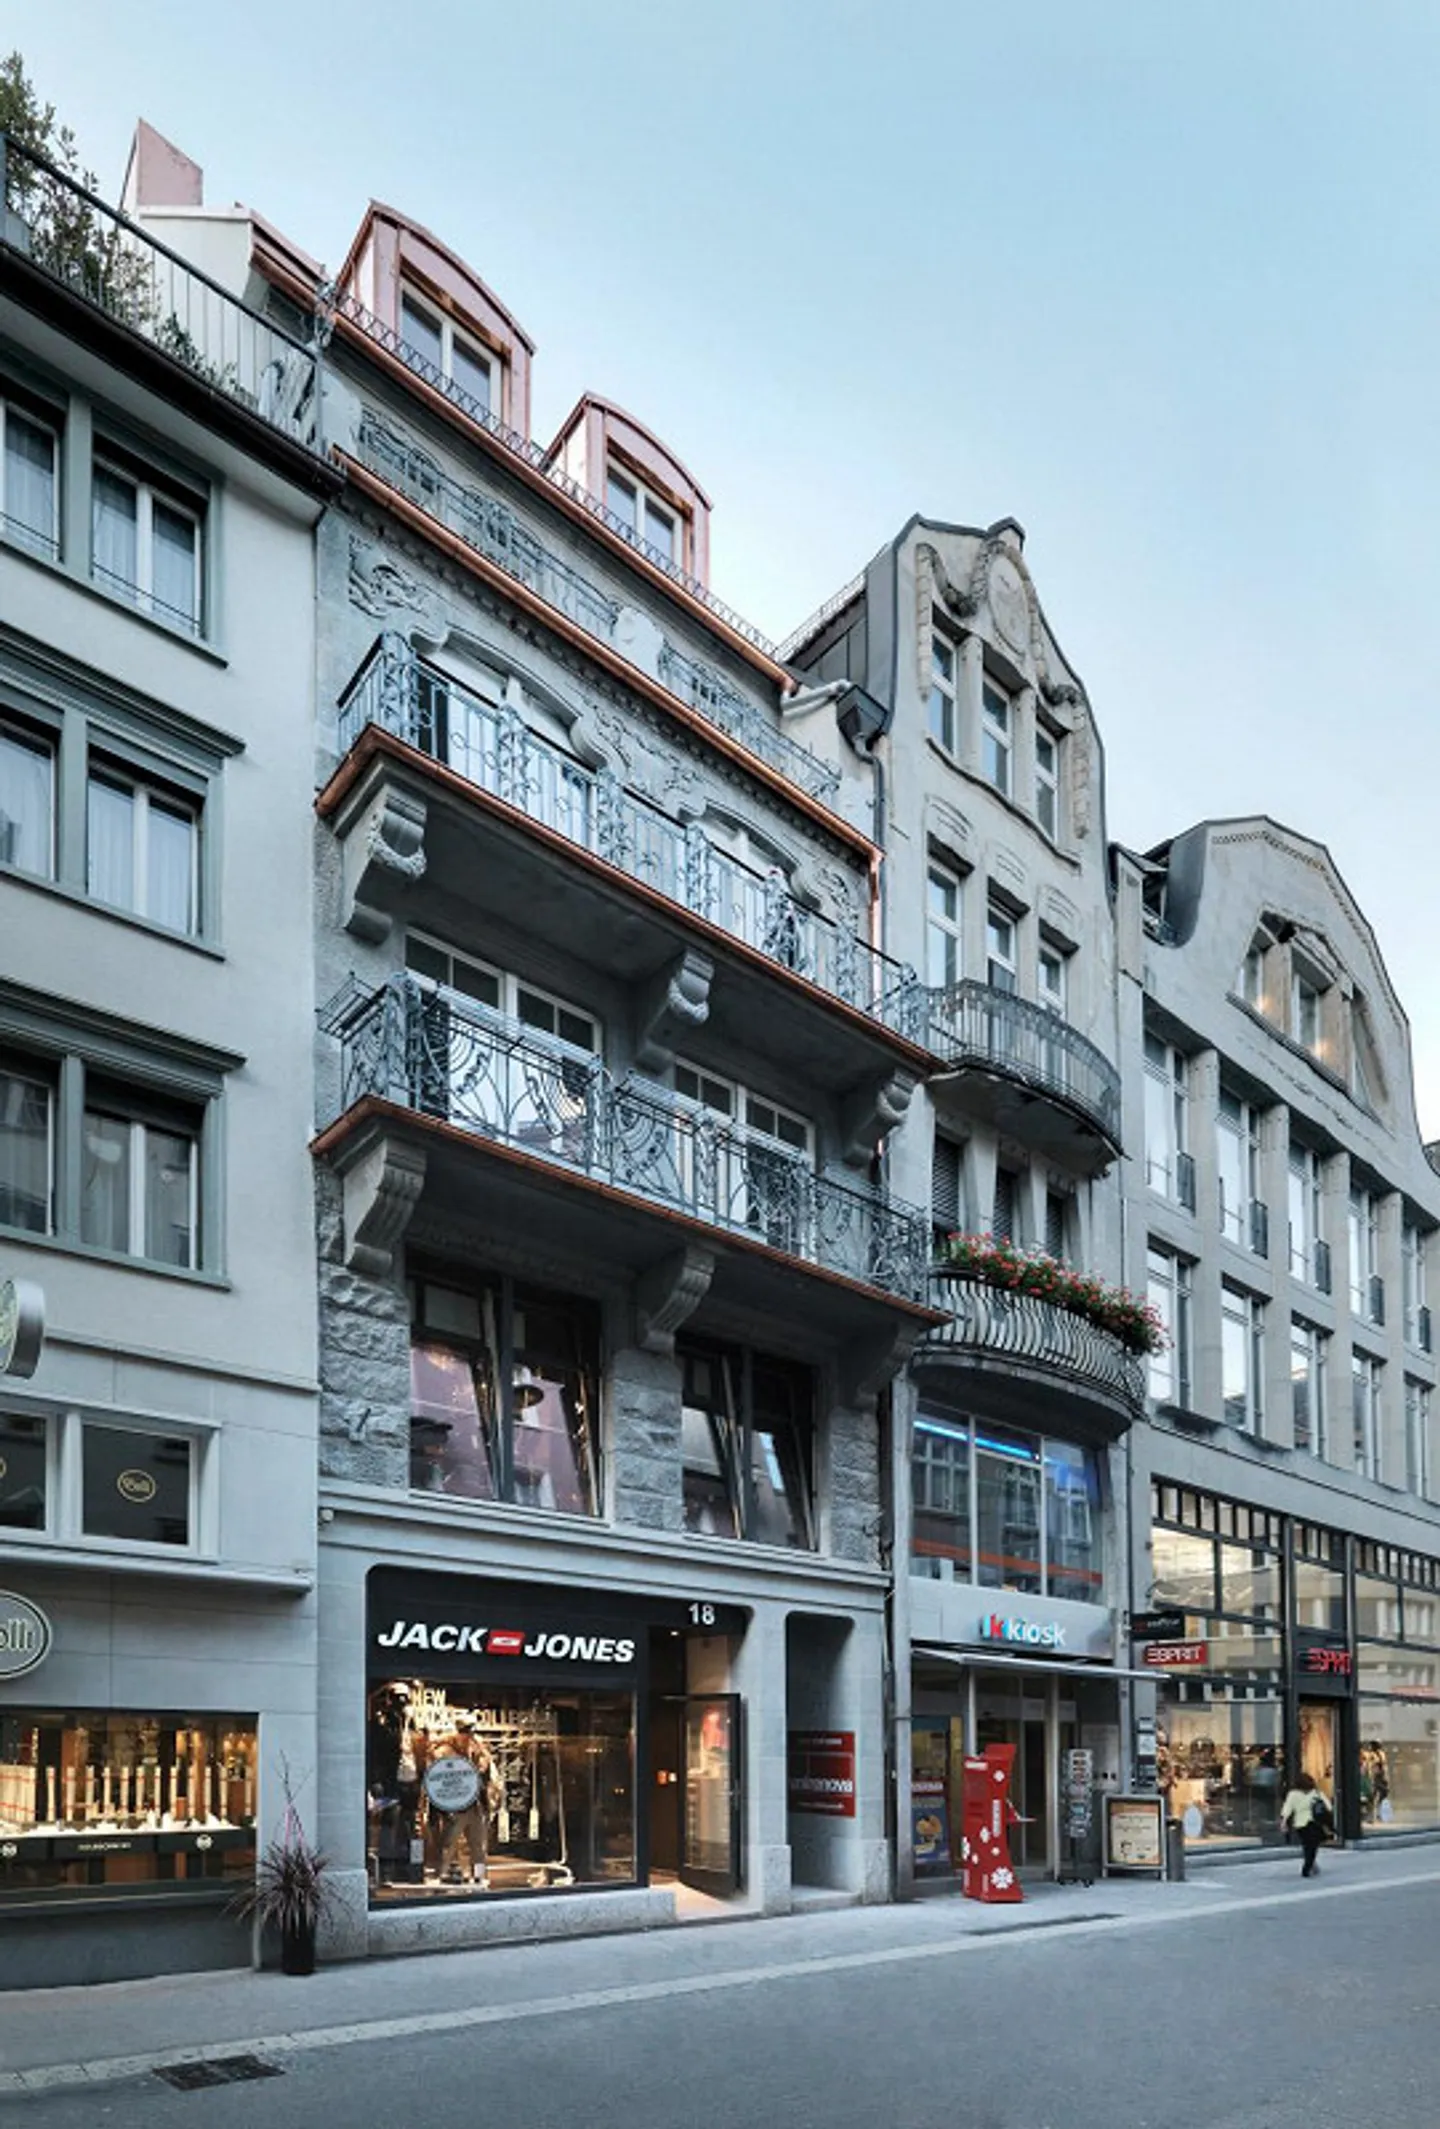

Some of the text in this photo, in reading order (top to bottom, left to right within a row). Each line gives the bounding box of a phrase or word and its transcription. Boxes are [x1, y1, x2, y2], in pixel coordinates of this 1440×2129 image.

[689, 1602, 716, 1625] 18
[378, 1621, 489, 1652] JACK
[524, 1633, 636, 1663] JONES
[1008, 1617, 1066, 1648] kiosk
[1147, 1645, 1202, 1662] ESPRIT
